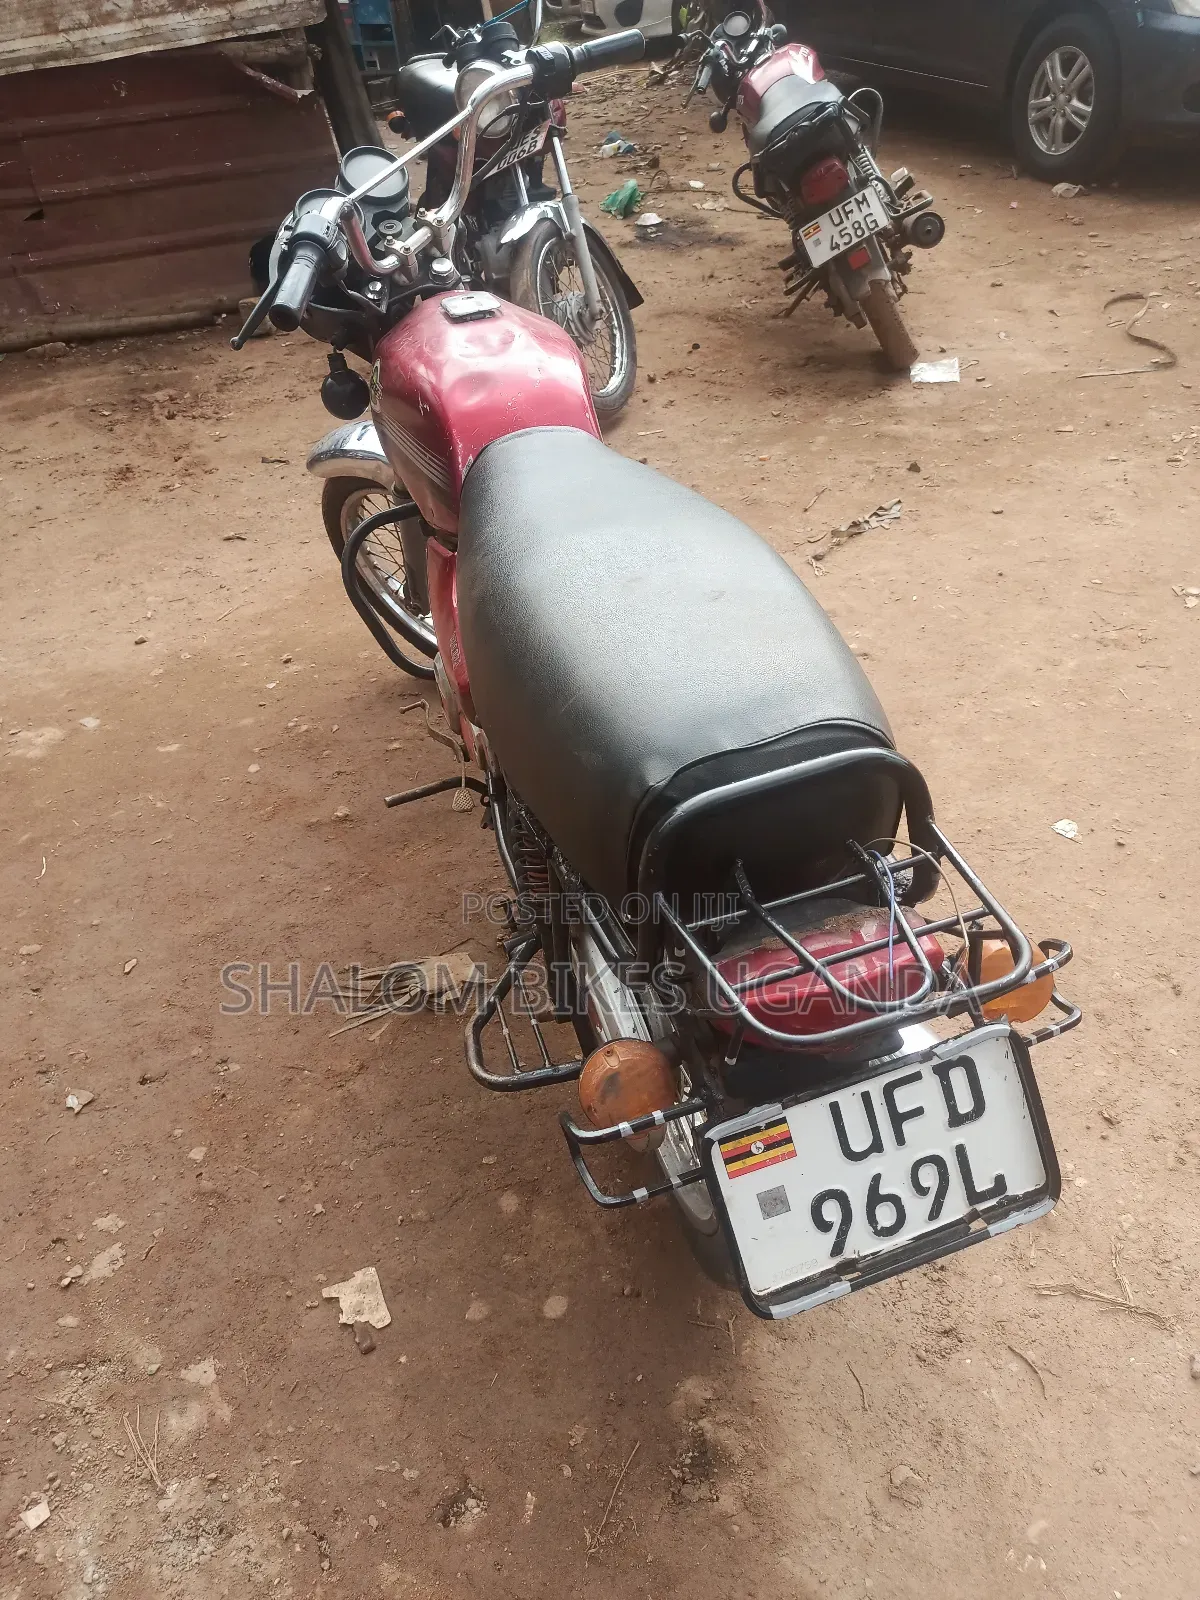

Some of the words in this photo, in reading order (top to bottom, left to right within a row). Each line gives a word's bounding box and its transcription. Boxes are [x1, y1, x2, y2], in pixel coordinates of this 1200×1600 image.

[828, 193, 871, 227] UFM
[829, 213, 879, 252] 458G
[828, 1055, 986, 1162] UFD
[810, 1143, 1007, 1258] 969L
